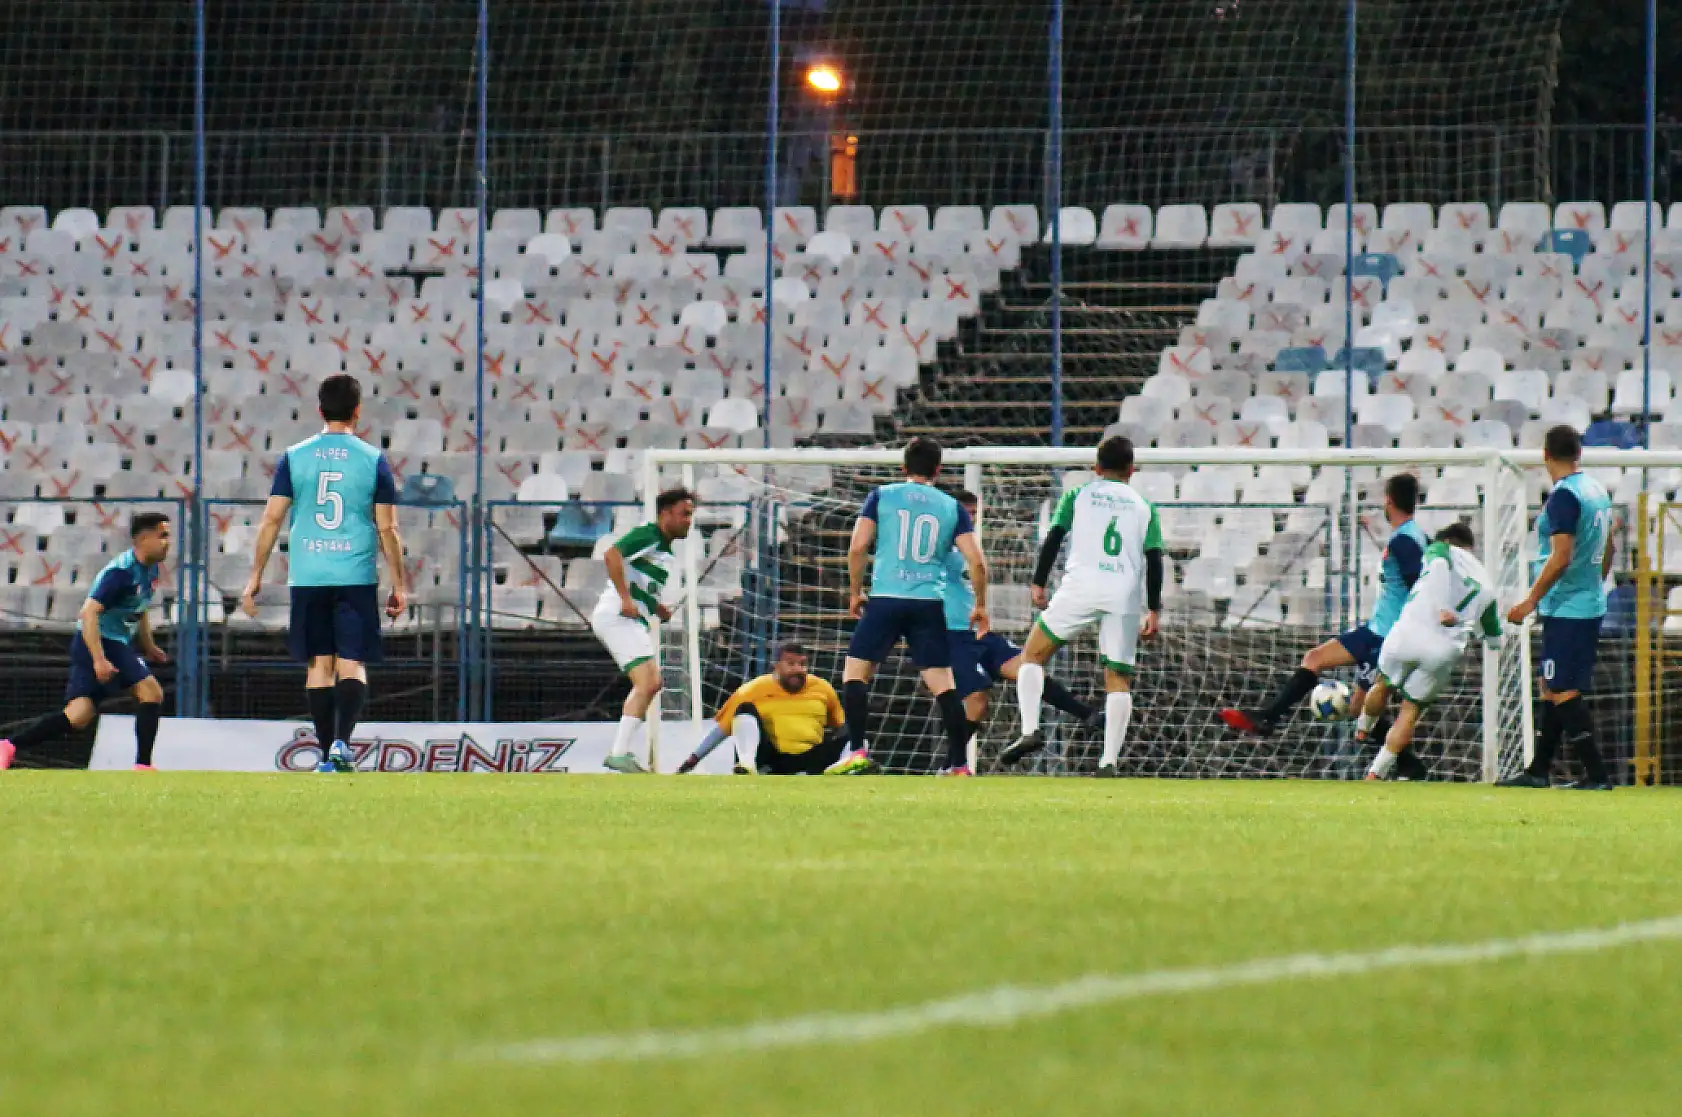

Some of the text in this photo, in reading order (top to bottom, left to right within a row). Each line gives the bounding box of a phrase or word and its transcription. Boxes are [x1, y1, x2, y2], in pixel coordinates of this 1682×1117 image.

[315, 471, 343, 530] 5
[897, 509, 939, 564] 10
[1103, 515, 1123, 556] 6
[1591, 507, 1612, 564] 2
[1455, 576, 1481, 612] 7
